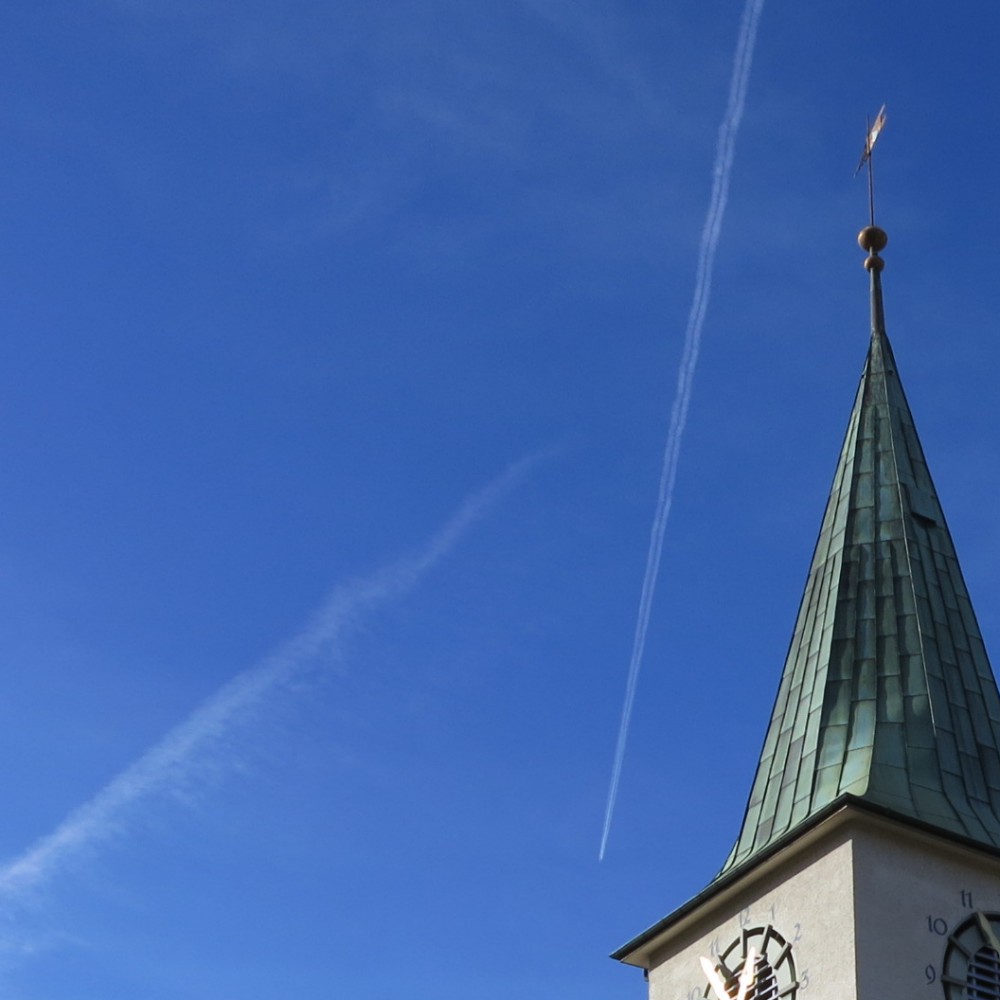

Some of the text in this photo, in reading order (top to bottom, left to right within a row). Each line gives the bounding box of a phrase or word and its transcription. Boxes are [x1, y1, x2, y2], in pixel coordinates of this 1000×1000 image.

[960, 890, 972, 908] 11
[739, 908, 751, 928] 12
[769, 903, 775, 920] 1
[794, 923, 802, 942] 2
[928, 916, 947, 935] 10
[710, 936, 720, 957] 11
[801, 969, 809, 989] 3
[925, 965, 936, 983] 9
